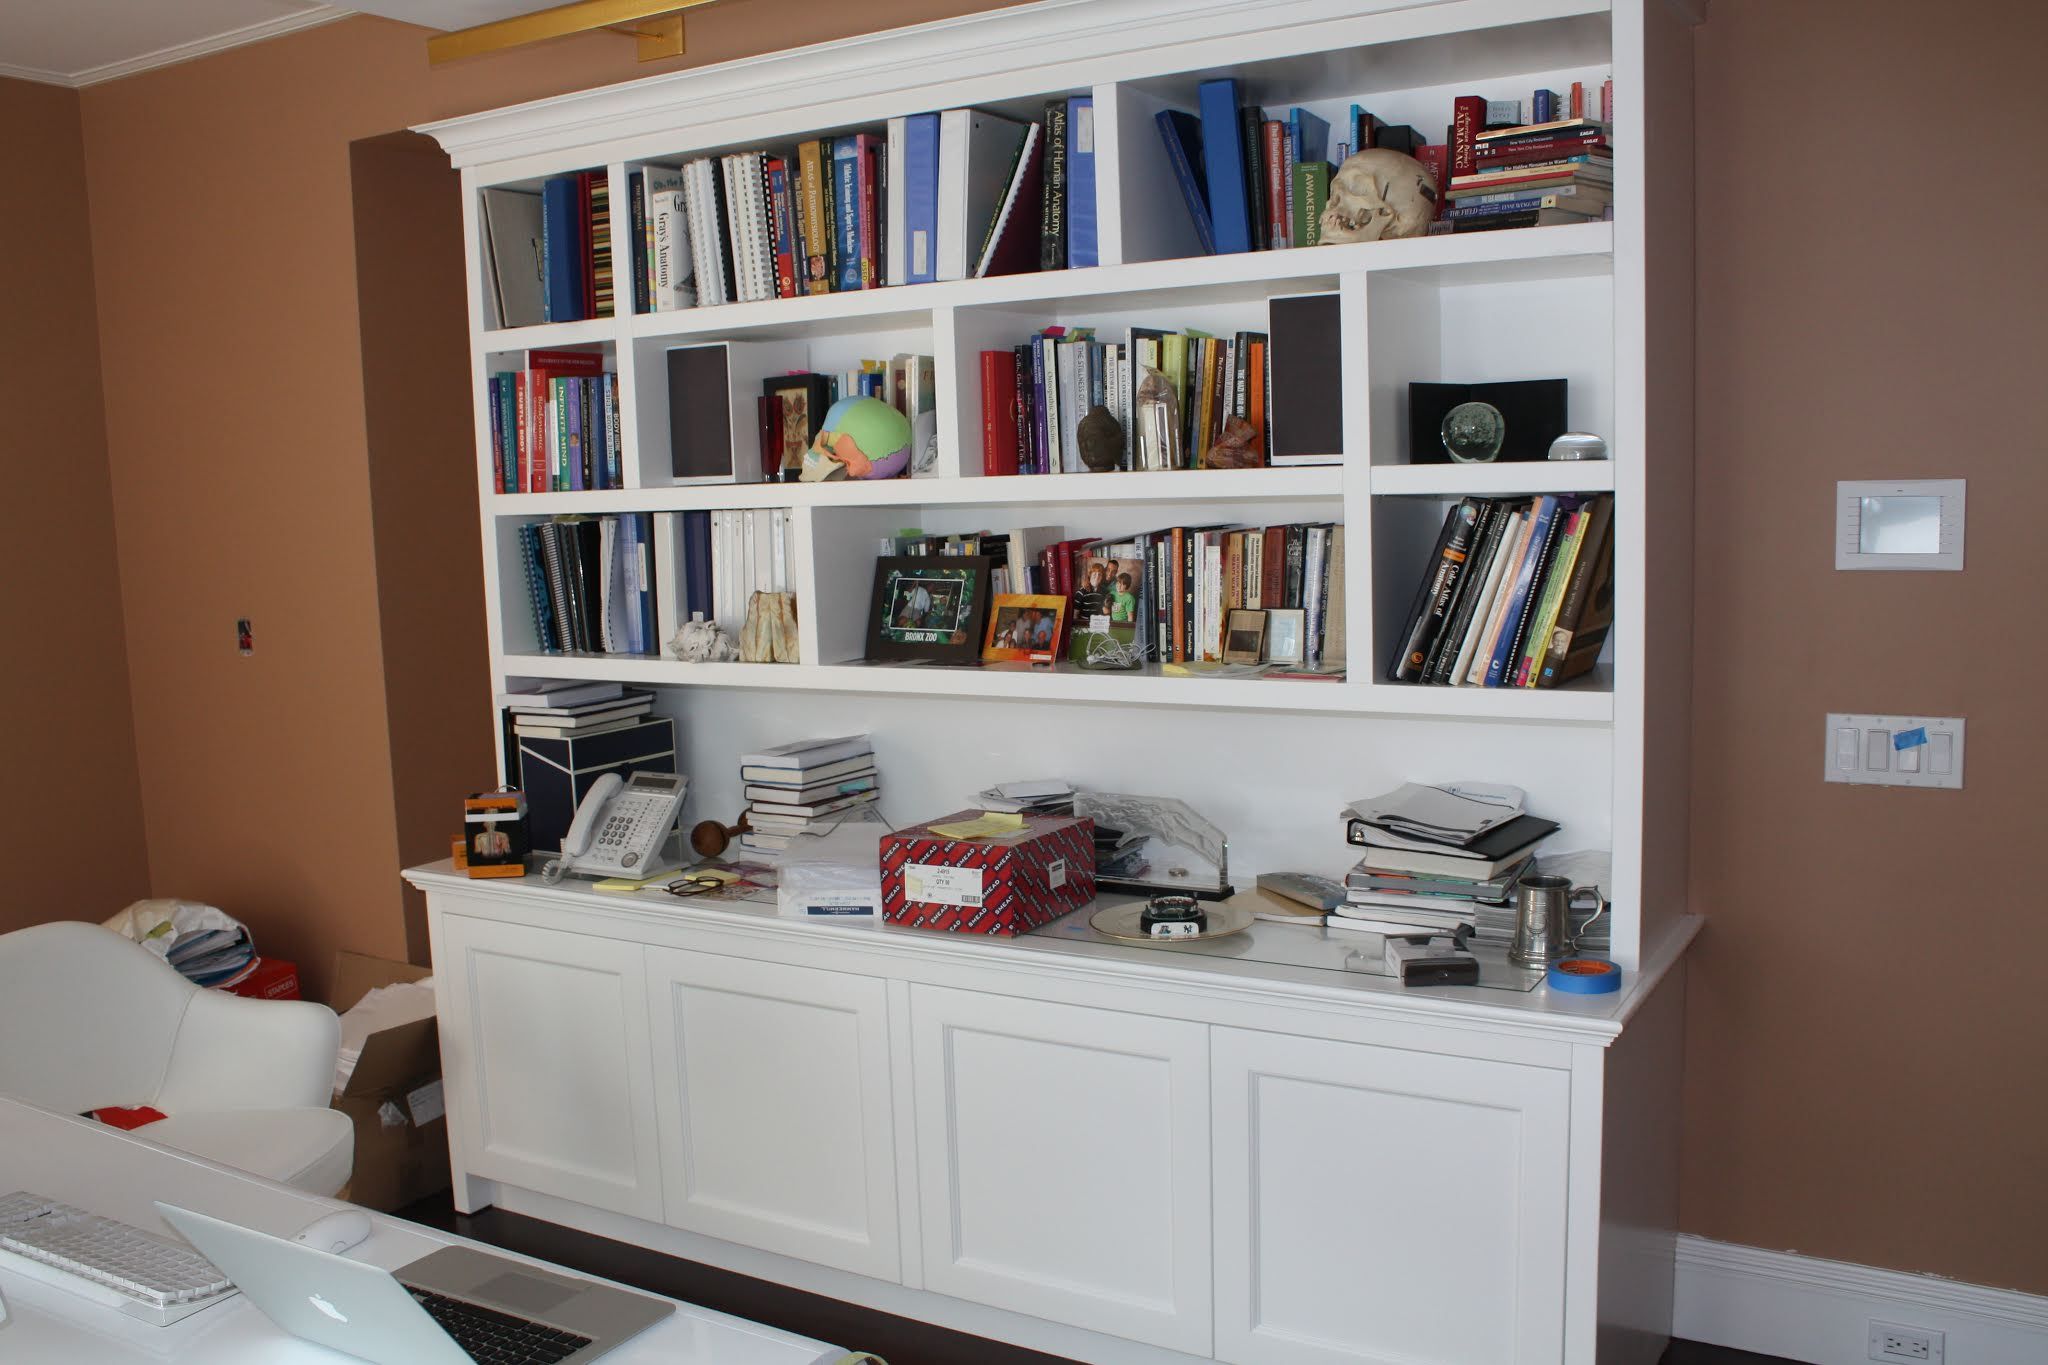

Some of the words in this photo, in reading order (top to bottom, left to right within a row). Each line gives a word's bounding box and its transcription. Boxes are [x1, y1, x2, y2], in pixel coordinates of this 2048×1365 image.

[1054, 111, 1065, 136] Atlas
[1054, 137, 1064, 150] of
[1456, 112, 1465, 169] ALMANAC
[1271, 138, 1280, 167] Pituitary
[844, 164, 852, 182] Athletic
[1053, 151, 1063, 188] Human
[844, 183, 853, 204] Training
[1050, 191, 1062, 236] Anatomy
[1305, 173, 1315, 245] AWAKENINGS
[1461, 208, 1478, 216] FIELD
[657, 213, 670, 242] Gray's
[846, 214, 854, 231] Sports
[658, 245, 670, 288] Anatomy
[1079, 394, 1085, 403] OF
[1224, 385, 1233, 411] HEALING
[558, 386, 567, 433] INFINITE
[1237, 406, 1244, 414] ON
[1430, 562, 1450, 597] Anatomy
[1450, 564, 1460, 582] Color
[1442, 583, 1452, 605] Atlas
[1435, 606, 1443, 618] of
[904, 631, 924, 642] BRONX
[925, 632, 938, 642] ZOO
[883, 842, 900, 862] SMEAD
[918, 845, 938, 864] SMEAD
[956, 848, 975, 868] SMEAD
[885, 885, 900, 904] SMEAD
[981, 879, 1000, 900] SMEAD
[896, 900, 912, 920] SMEAD
[930, 904, 948, 924] SMEAD
[968, 908, 987, 928] SMEAD
[268, 980, 294, 996] STAPLES
